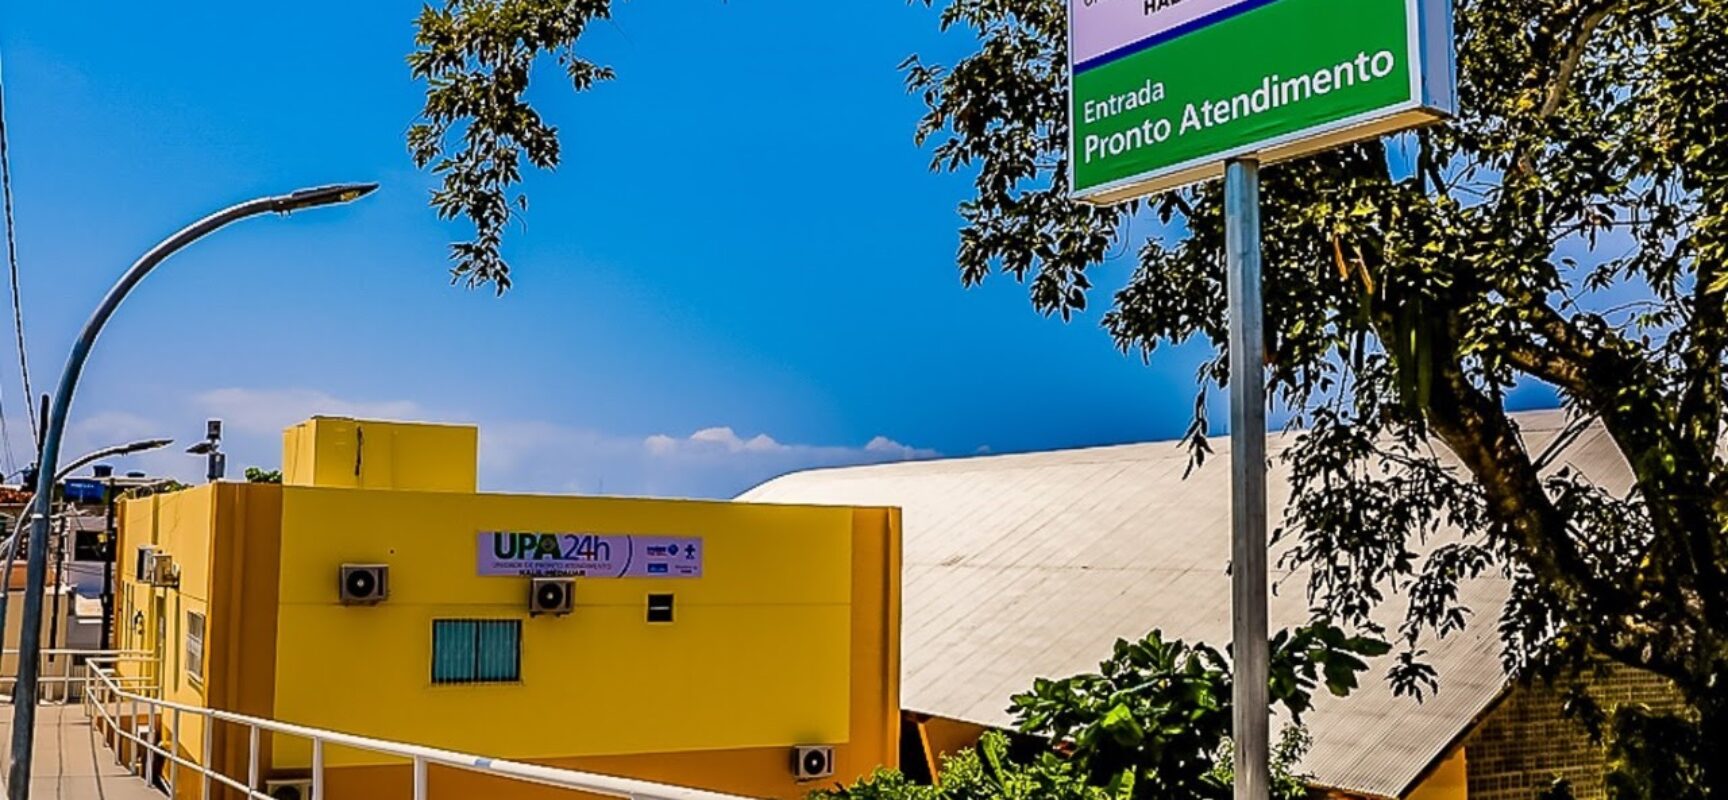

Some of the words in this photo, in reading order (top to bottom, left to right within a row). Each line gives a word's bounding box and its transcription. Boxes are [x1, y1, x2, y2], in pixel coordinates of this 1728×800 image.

[1084, 80, 1165, 124] Entrada
[1084, 118, 1171, 163] Pronto
[1179, 49, 1395, 136] Atendimento
